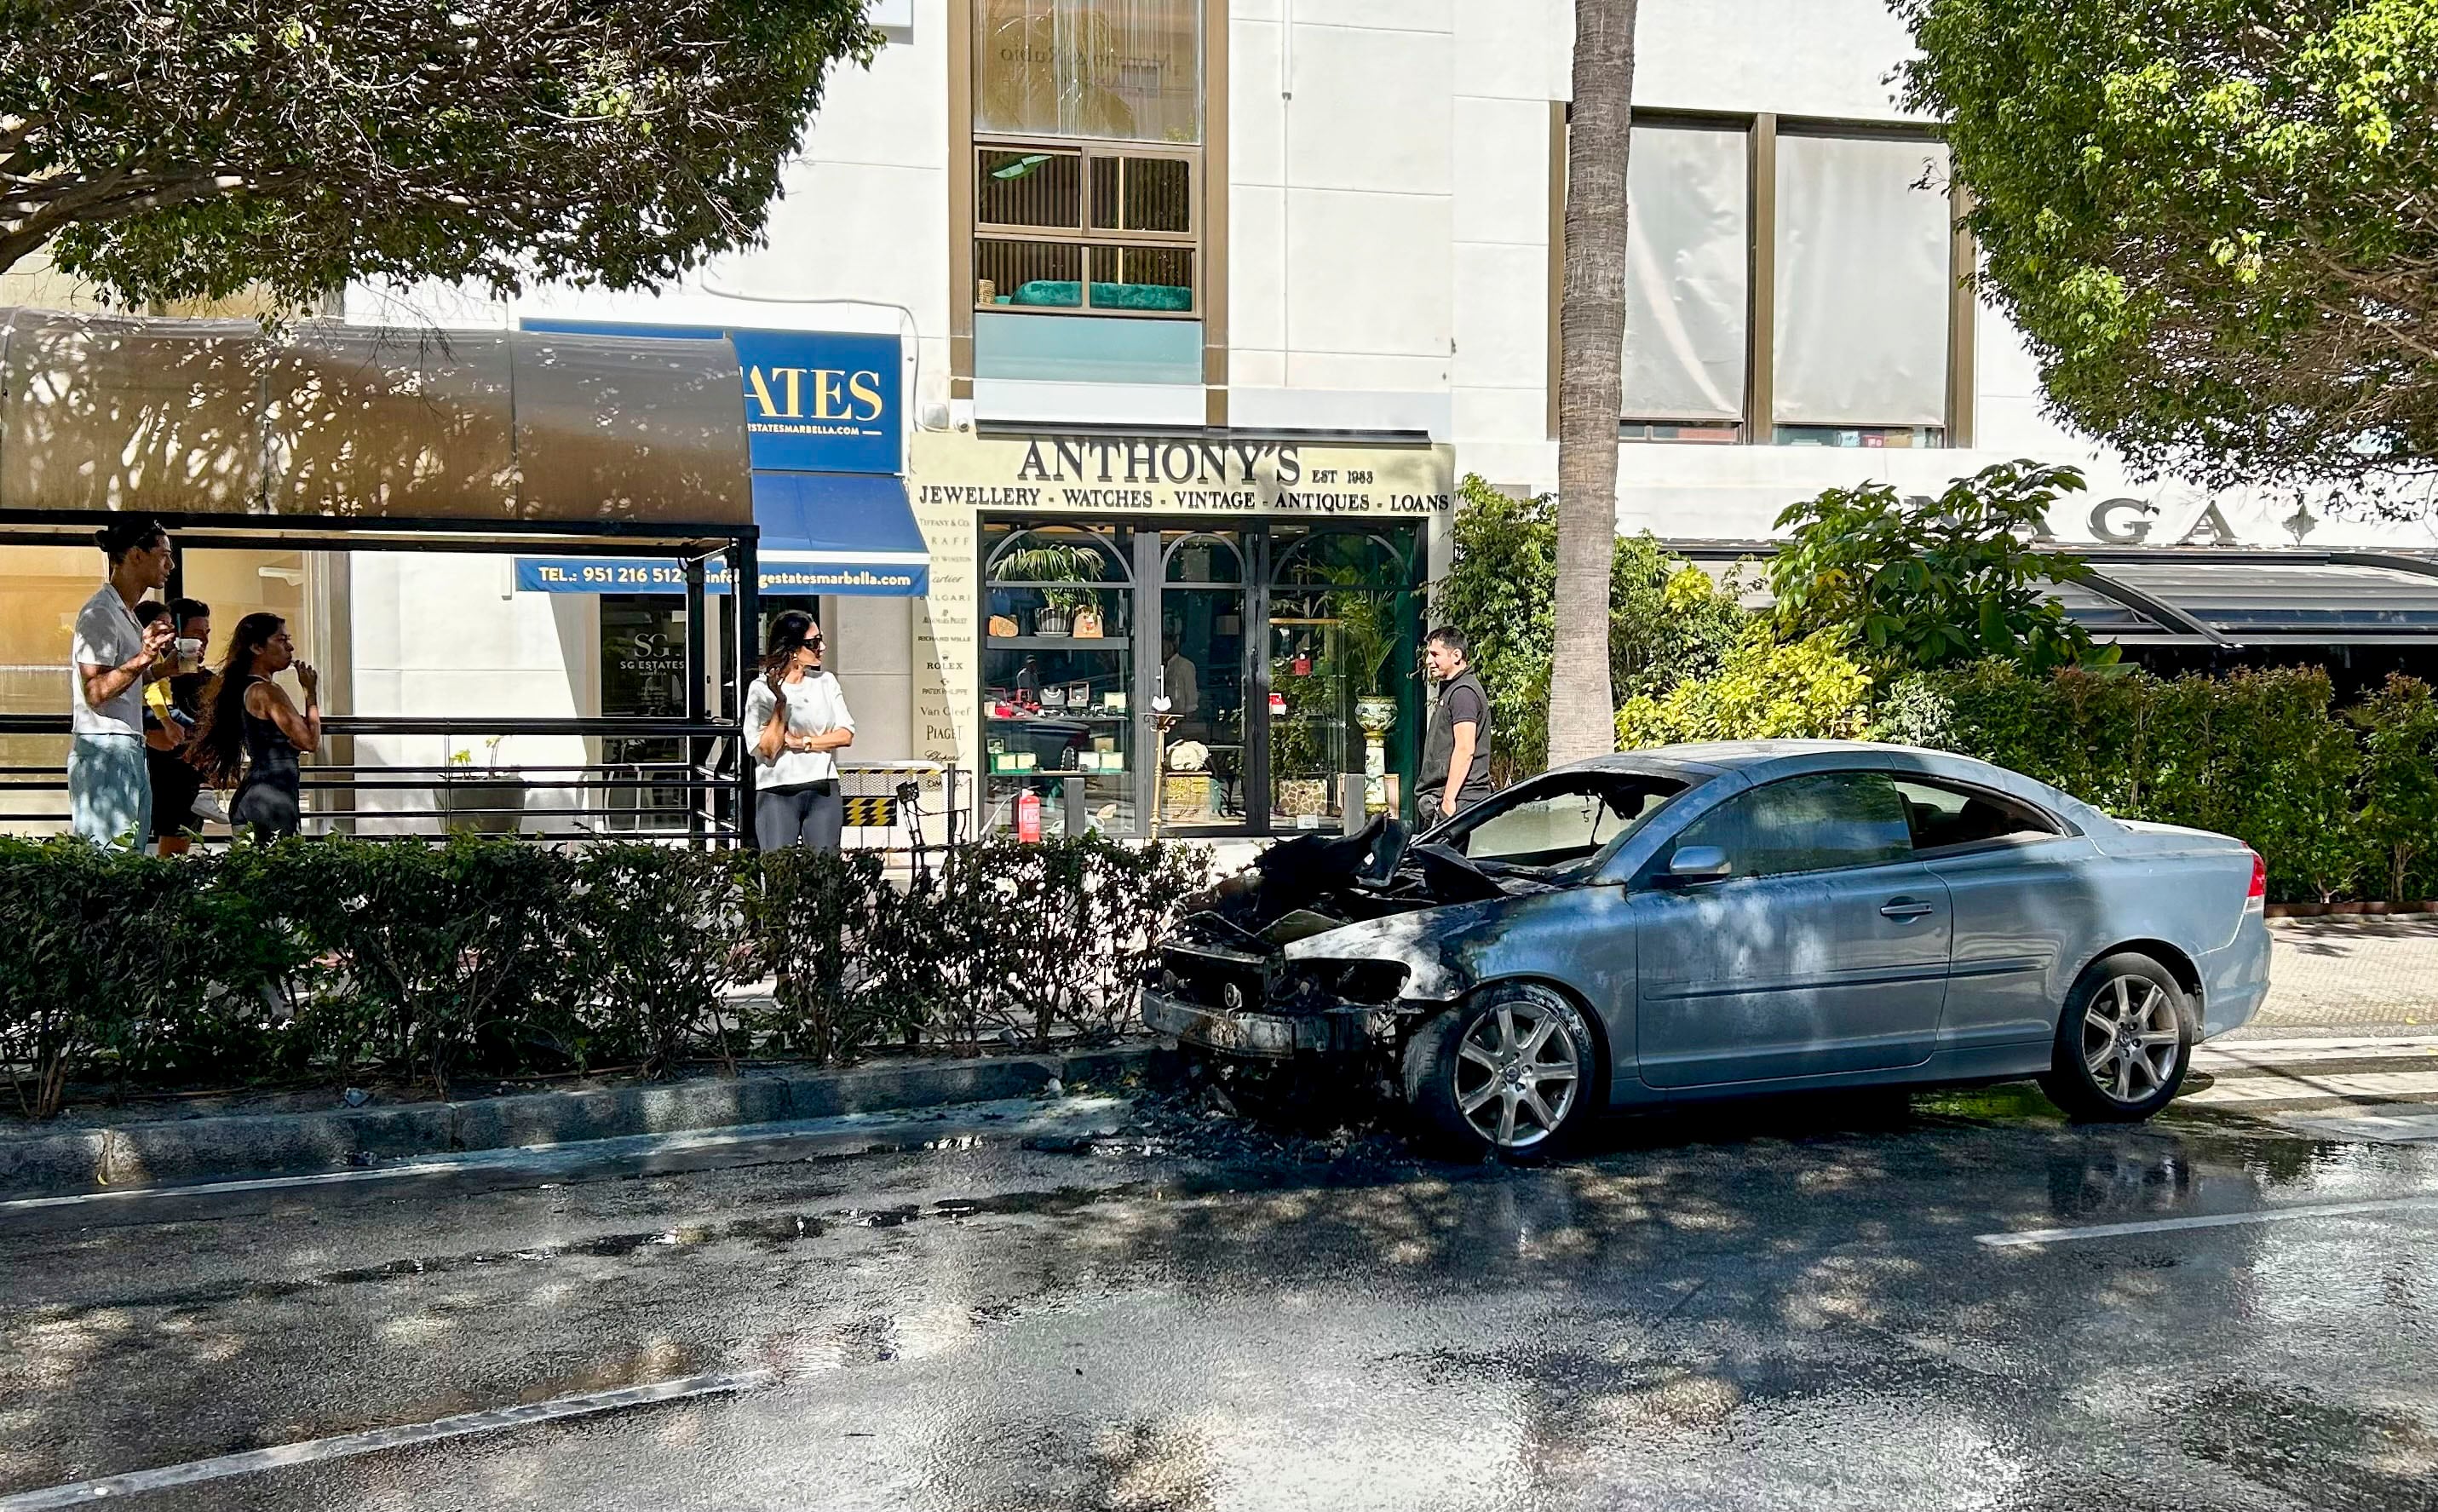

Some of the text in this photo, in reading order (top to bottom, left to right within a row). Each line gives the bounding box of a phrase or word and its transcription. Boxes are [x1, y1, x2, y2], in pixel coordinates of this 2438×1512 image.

[739, 365, 883, 422] ATES
[1017, 435, 1302, 486] ANTHONY'S
[1312, 469, 1338, 484] EST
[919, 487, 1450, 513] JEWELLERY WATCHES VINTAGE ANTIQUES LOANS
[932, 537, 969, 546] RAFF
[583, 567, 613, 583] 951
[618, 567, 648, 584] 216
[653, 567, 682, 584] 512
[930, 572, 964, 584] artier
[620, 660, 685, 670] SG ESTATES
[921, 706, 972, 716] Van Cleef
[927, 725, 963, 741] PIAGET
